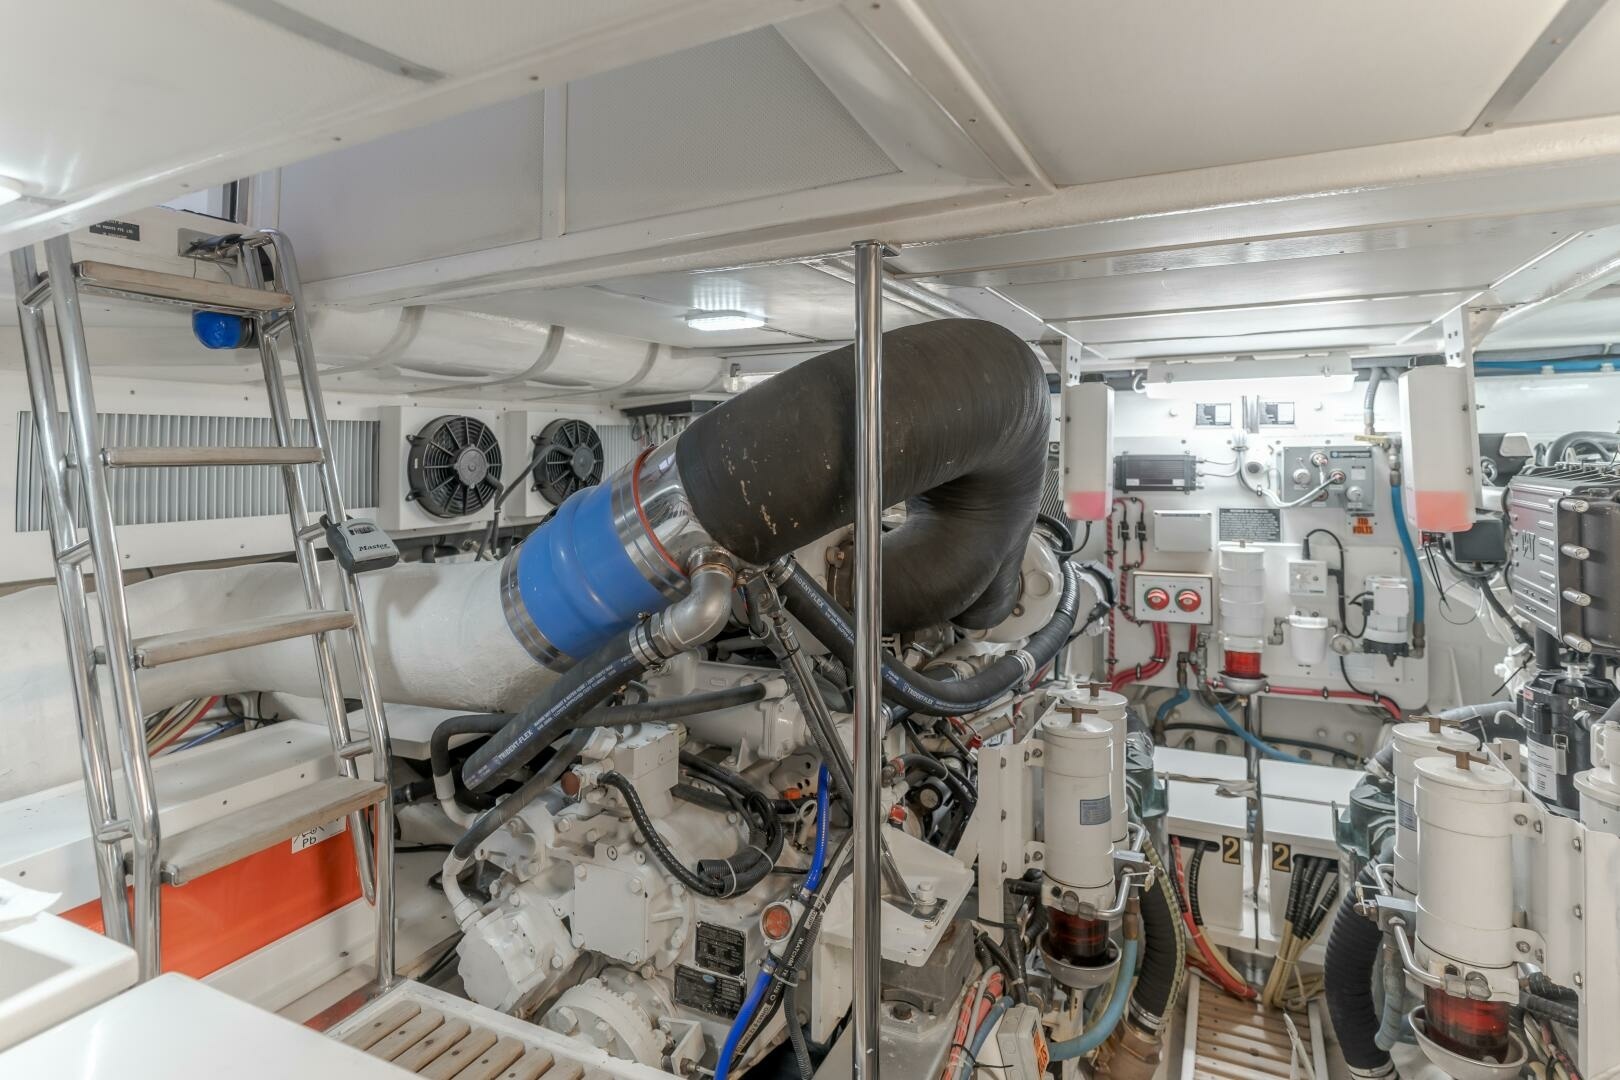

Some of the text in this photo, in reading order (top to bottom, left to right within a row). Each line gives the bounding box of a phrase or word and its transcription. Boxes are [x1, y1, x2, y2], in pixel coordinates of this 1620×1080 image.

[1353, 526, 1373, 534] VOLTS
[359, 543, 388, 551] Master
[792, 573, 826, 608] RIDENT-FLEX
[498, 729, 534, 761] TRIDENT-FLEX
[302, 836, 317, 848] Pb
[1224, 837, 1239, 862] 2
[1274, 844, 1290, 871] 2
